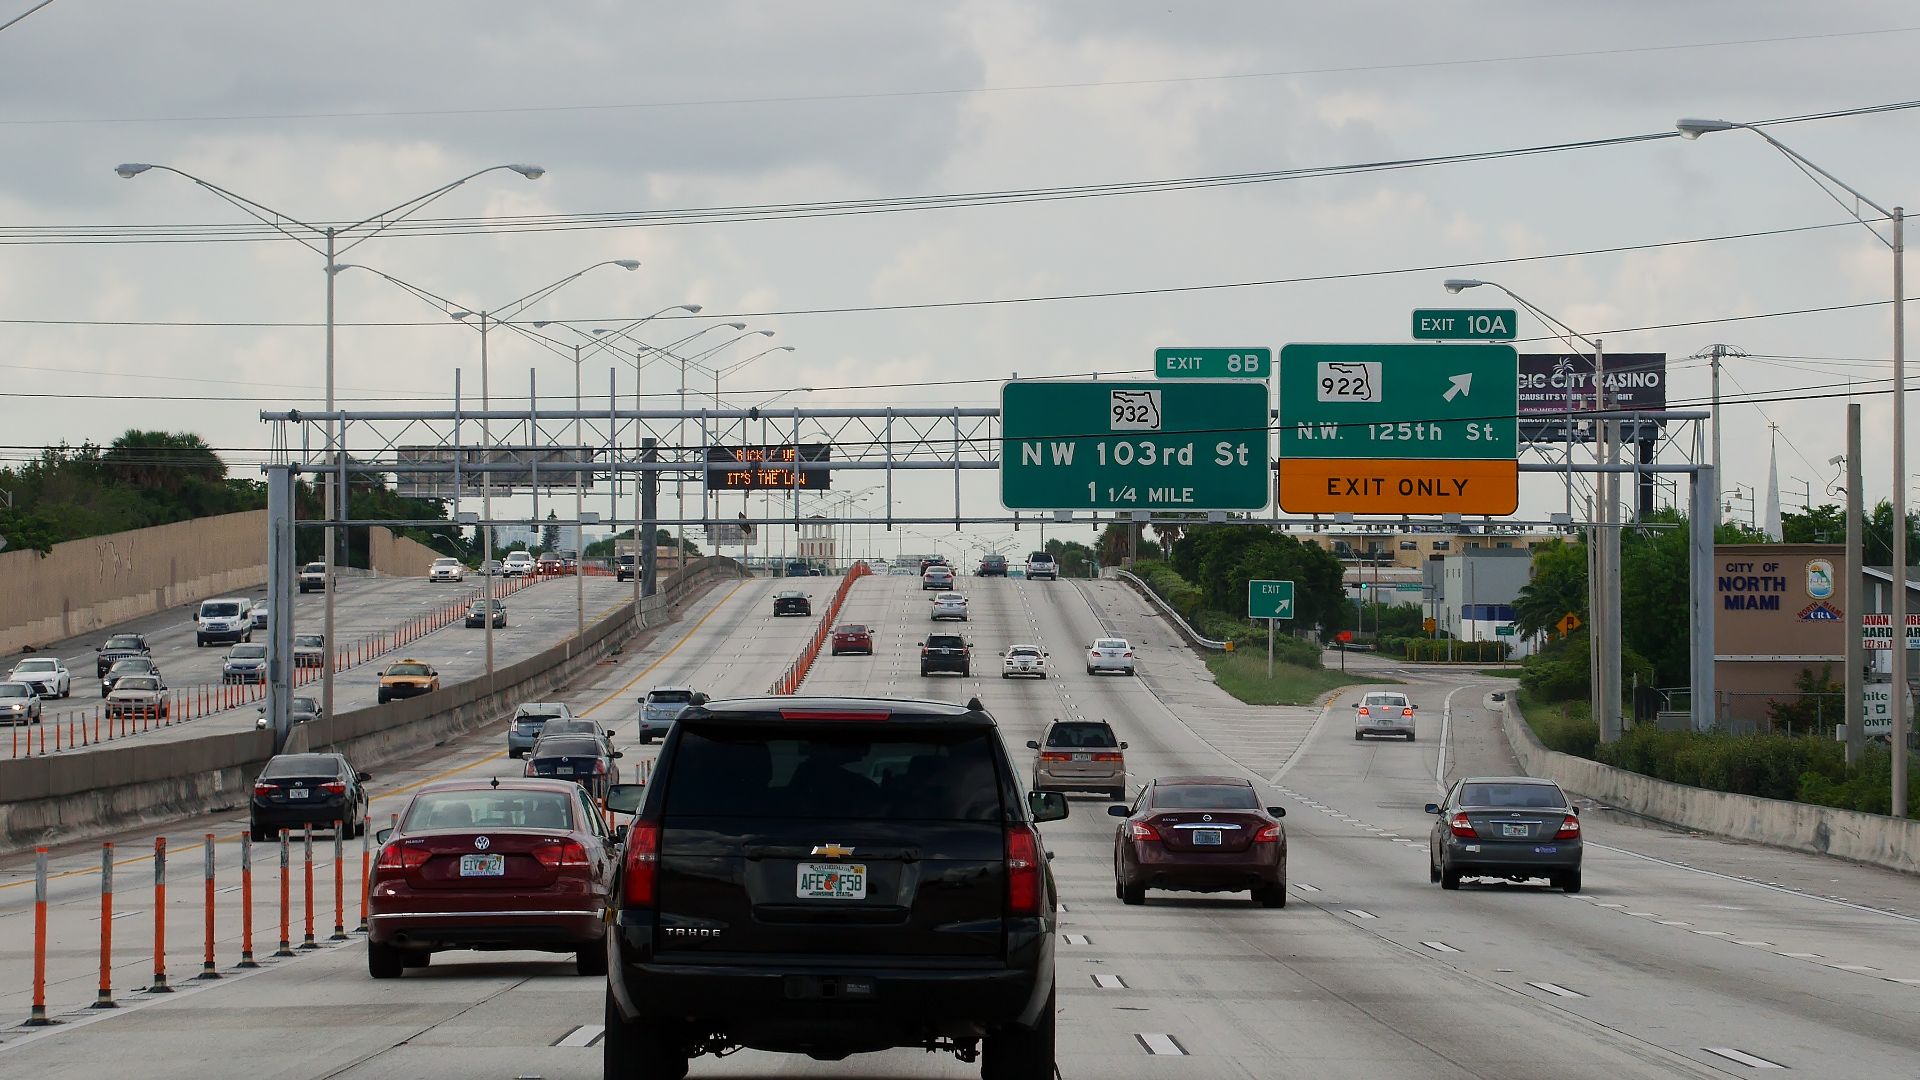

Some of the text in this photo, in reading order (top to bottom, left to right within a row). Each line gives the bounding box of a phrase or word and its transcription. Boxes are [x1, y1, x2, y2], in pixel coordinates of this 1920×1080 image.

[1421, 316, 1507, 334] EXIT 10A
[1167, 354, 1259, 372] EXIT 8B
[1322, 378, 1364, 395] 922
[1518, 373, 1546, 389] GIC
[1592, 372, 1659, 388] CASINO
[1518, 393, 1545, 401] CAUSE
[1113, 405, 1149, 423] 932
[1297, 422, 1499, 441] N.W. 125th St.
[1022, 441, 1249, 466] NW 103rd St
[727, 472, 751, 485] IT'S
[757, 472, 778, 485] THE
[1088, 482, 1194, 503] 1 1/4 MILE
[1327, 478, 1469, 497] EXIT ONLY
[1726, 562, 1779, 572] CITY OF
[1262, 584, 1281, 594] EXIT
[1718, 576, 1786, 592] NORTH
[1724, 595, 1780, 610] MIAMI
[1862, 615, 1889, 626] AVAN
[1863, 691, 1888, 701] hite
[665, 928, 721, 937] TAHOE
